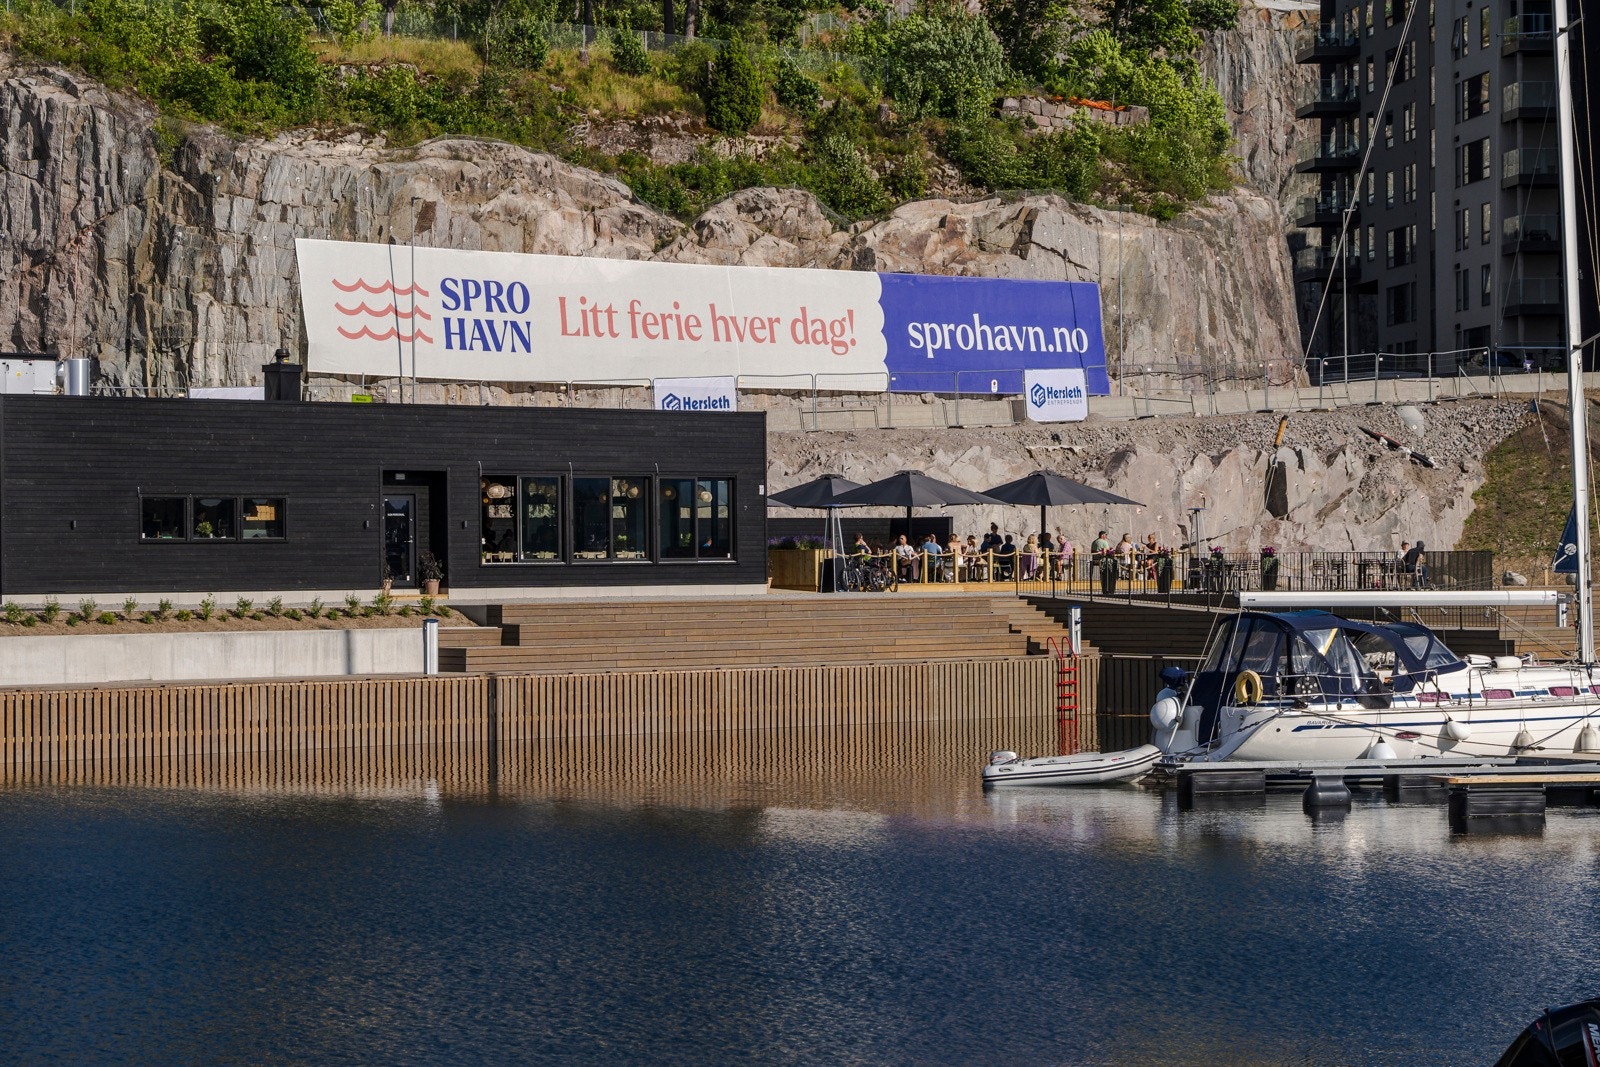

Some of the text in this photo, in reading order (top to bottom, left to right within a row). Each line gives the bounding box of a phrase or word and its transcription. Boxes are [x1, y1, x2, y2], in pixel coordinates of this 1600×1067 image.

[440, 278, 531, 314] SPRO
[443, 317, 531, 353] HAVN
[558, 295, 858, 356] Litt ferie hver dag!
[907, 313, 1089, 359] sprohavn.no
[683, 395, 730, 410] Hersleth
[1047, 386, 1082, 399] Hersleth
